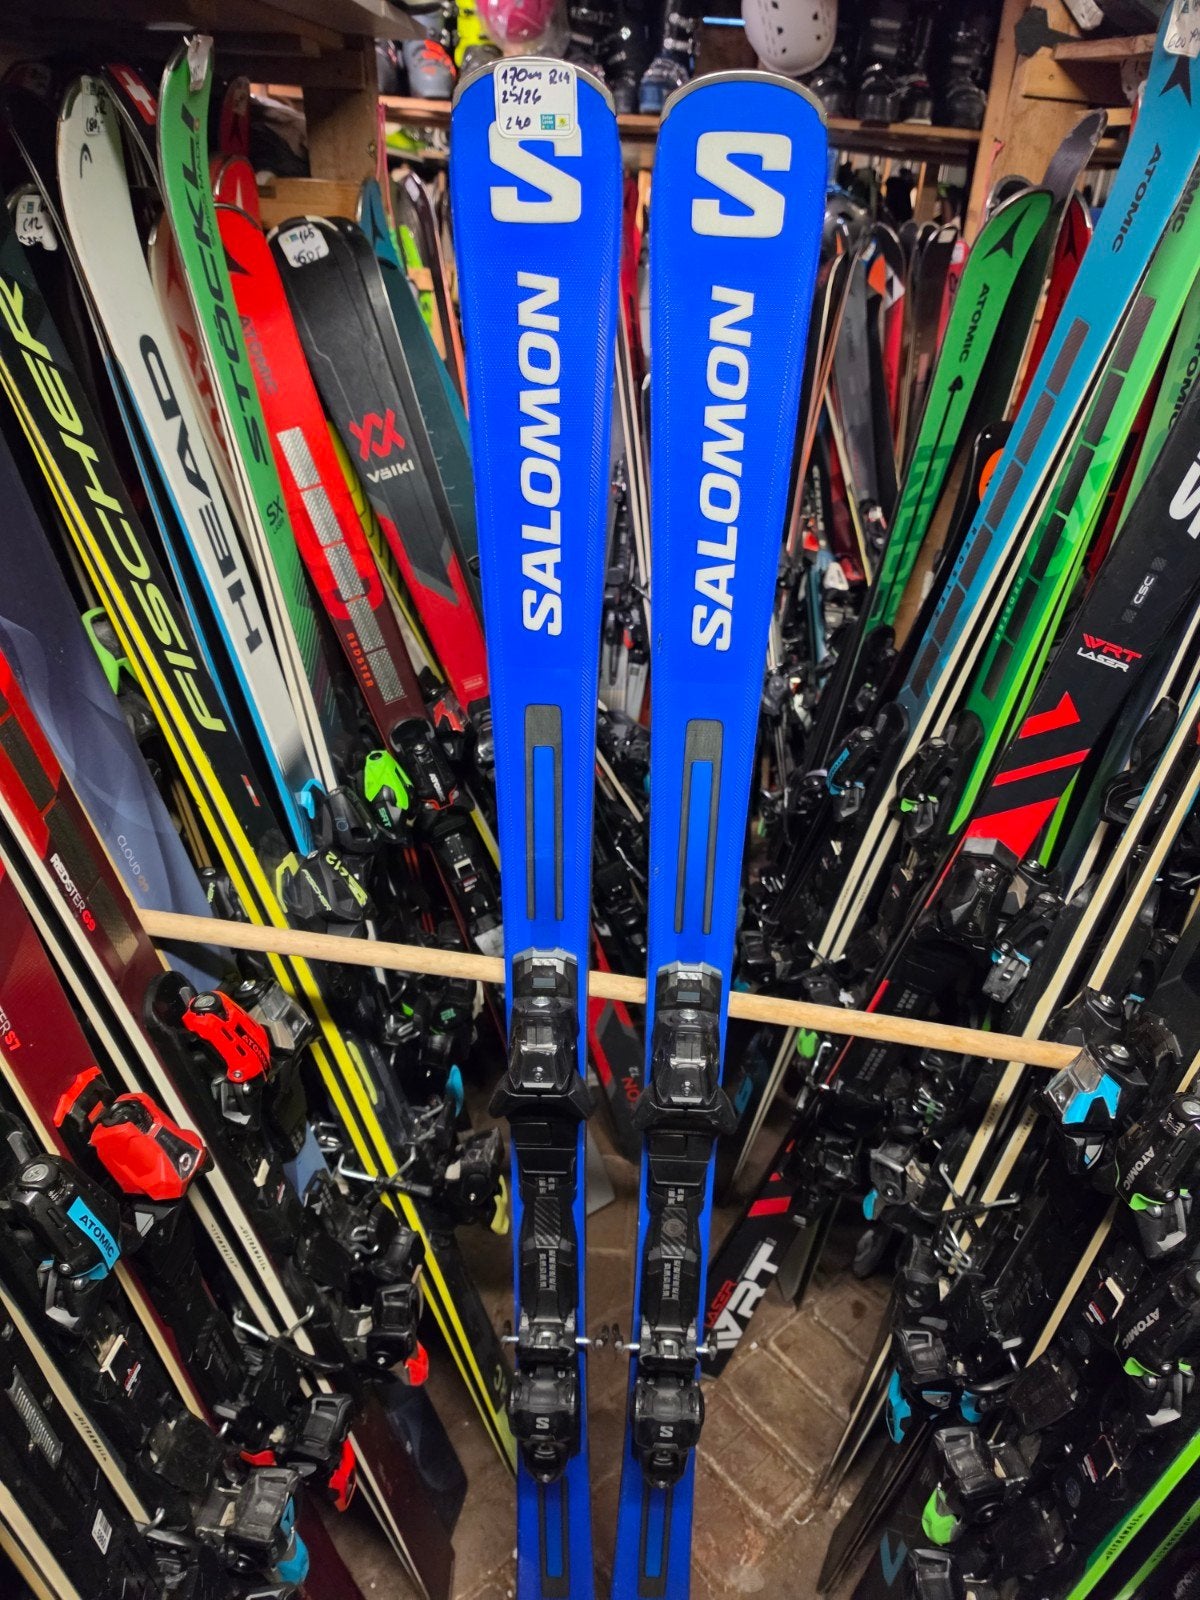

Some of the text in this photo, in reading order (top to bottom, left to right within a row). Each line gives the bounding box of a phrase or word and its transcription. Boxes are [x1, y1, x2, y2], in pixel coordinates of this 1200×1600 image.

[1112, 143, 1161, 254] ATOMIC
[959, 283, 990, 363] ATOMIC
[516, 271, 562, 636] SALOMON
[691, 285, 754, 652] SALOMON
[139, 334, 263, 654] HEAD
[934, 526, 978, 619] REDSTER
[1133, 575, 1155, 605] CSC
[994, 576, 1023, 641] REDSTER
[345, 632, 374, 688] REDSTER
[1077, 647, 1130, 673] LASER
[1082, 633, 1142, 663] WRT
[50, 852, 86, 914] REDSTER
[117, 834, 141, 876] CLOUD
[1123, 1145, 1155, 1191] ATOMIC
[78, 1212, 115, 1259] ATOMIC
[1121, 1307, 1160, 1350] ATOMIC
